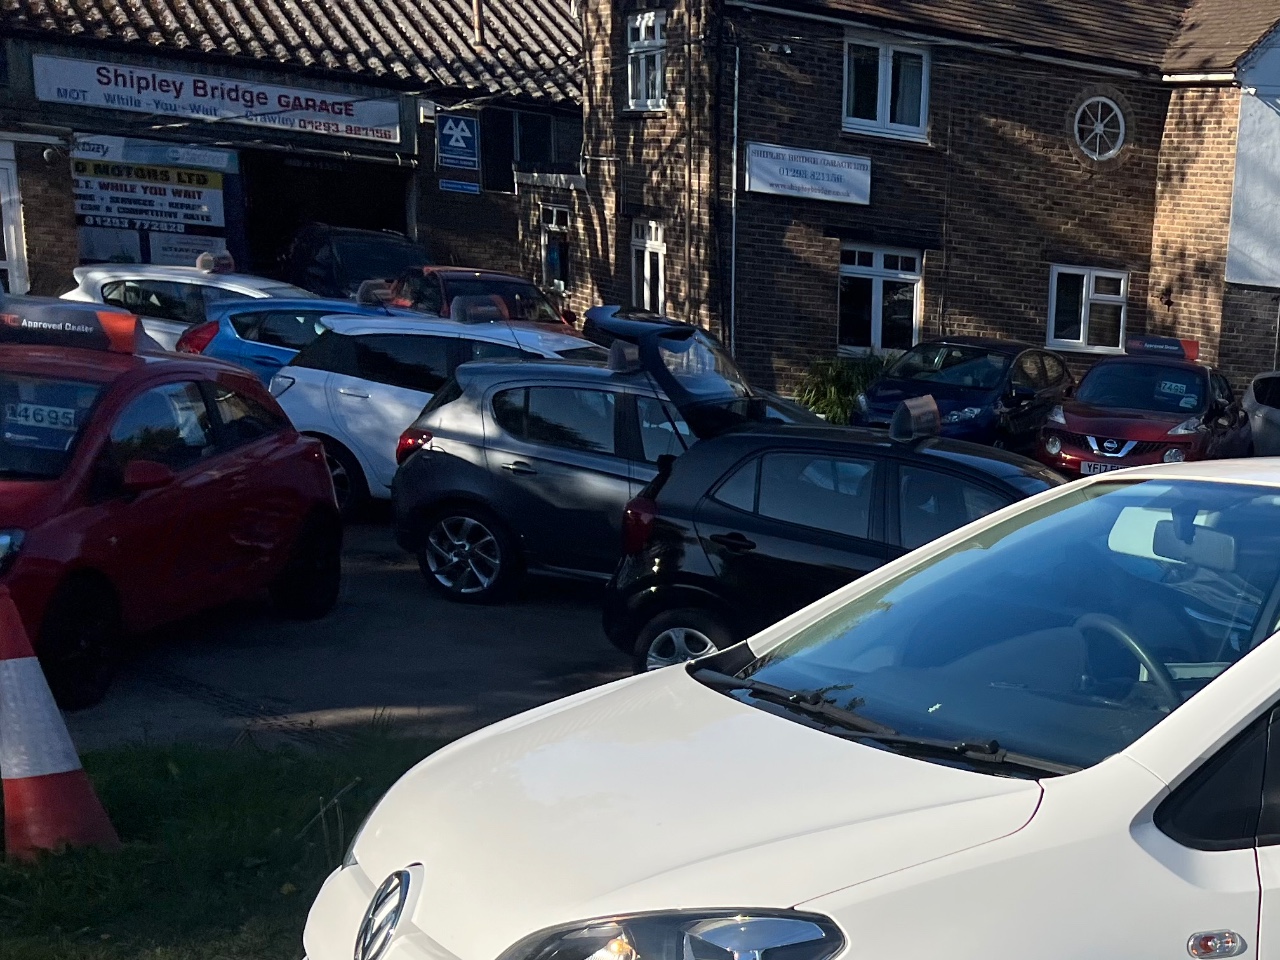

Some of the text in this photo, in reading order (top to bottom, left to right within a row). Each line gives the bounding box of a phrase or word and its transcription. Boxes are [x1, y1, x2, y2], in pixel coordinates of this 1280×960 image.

[56, 87, 89, 101] MOT
[95, 65, 355, 117] Shipley Bridge GARAGE
[751, 149, 787, 161] SHIPLEY
[93, 163, 171, 182] MOTORS
[176, 171, 209, 187] LTD
[98, 180, 138, 194] WHILE
[140, 184, 167, 197] YOU
[171, 186, 204, 200] WAIT
[21, 318, 63, 332] Approved
